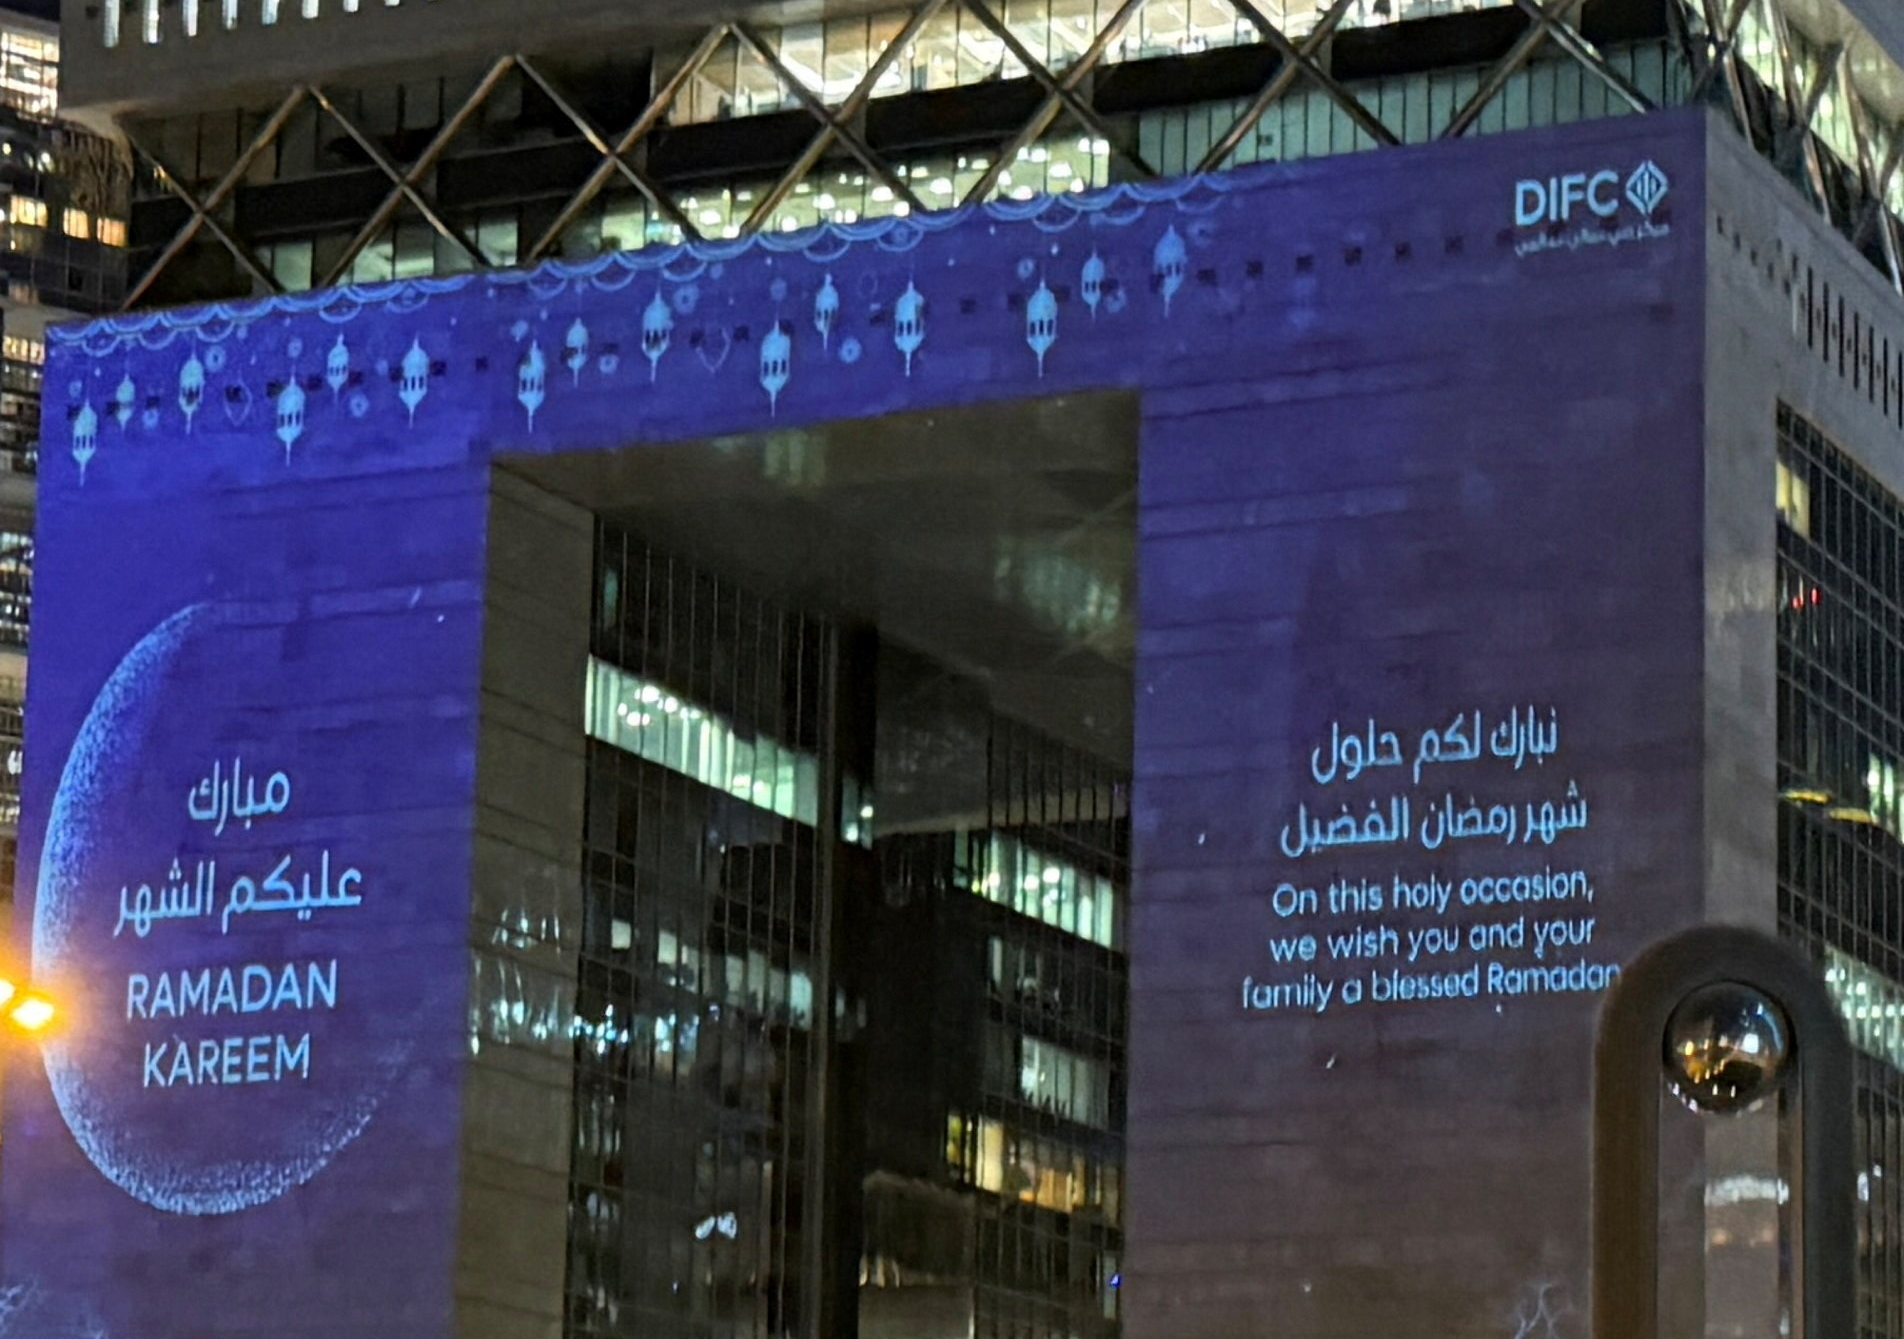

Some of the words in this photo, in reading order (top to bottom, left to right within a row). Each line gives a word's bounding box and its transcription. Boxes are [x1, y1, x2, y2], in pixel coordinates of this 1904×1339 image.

[1515, 169, 1619, 226] DIFC
[1311, 717, 1402, 784] حلول
[1413, 709, 1482, 784] لكم
[1491, 704, 1557, 769] نبارك
[188, 756, 290, 836] مبارك
[1280, 795, 1410, 857] الفضيل
[1421, 792, 1516, 849] رمضان
[1524, 779, 1587, 844] شهر
[113, 857, 215, 938] الشهر
[221, 849, 362, 934] عليكم
[1272, 882, 1318, 917] On
[1328, 878, 1383, 914] this
[1393, 874, 1452, 914] holy
[1459, 865, 1594, 904] occasion,
[1269, 934, 1317, 963] we
[1327, 925, 1399, 960] wish
[1408, 926, 1459, 962] you
[1469, 916, 1524, 950] and
[1534, 916, 1594, 959] your
[126, 959, 338, 1020] RAMADAN
[1242, 975, 1333, 1013] family
[1341, 981, 1363, 1005] a
[1372, 964, 1478, 1002] blessed
[143, 1032, 310, 1088] KAREEM
